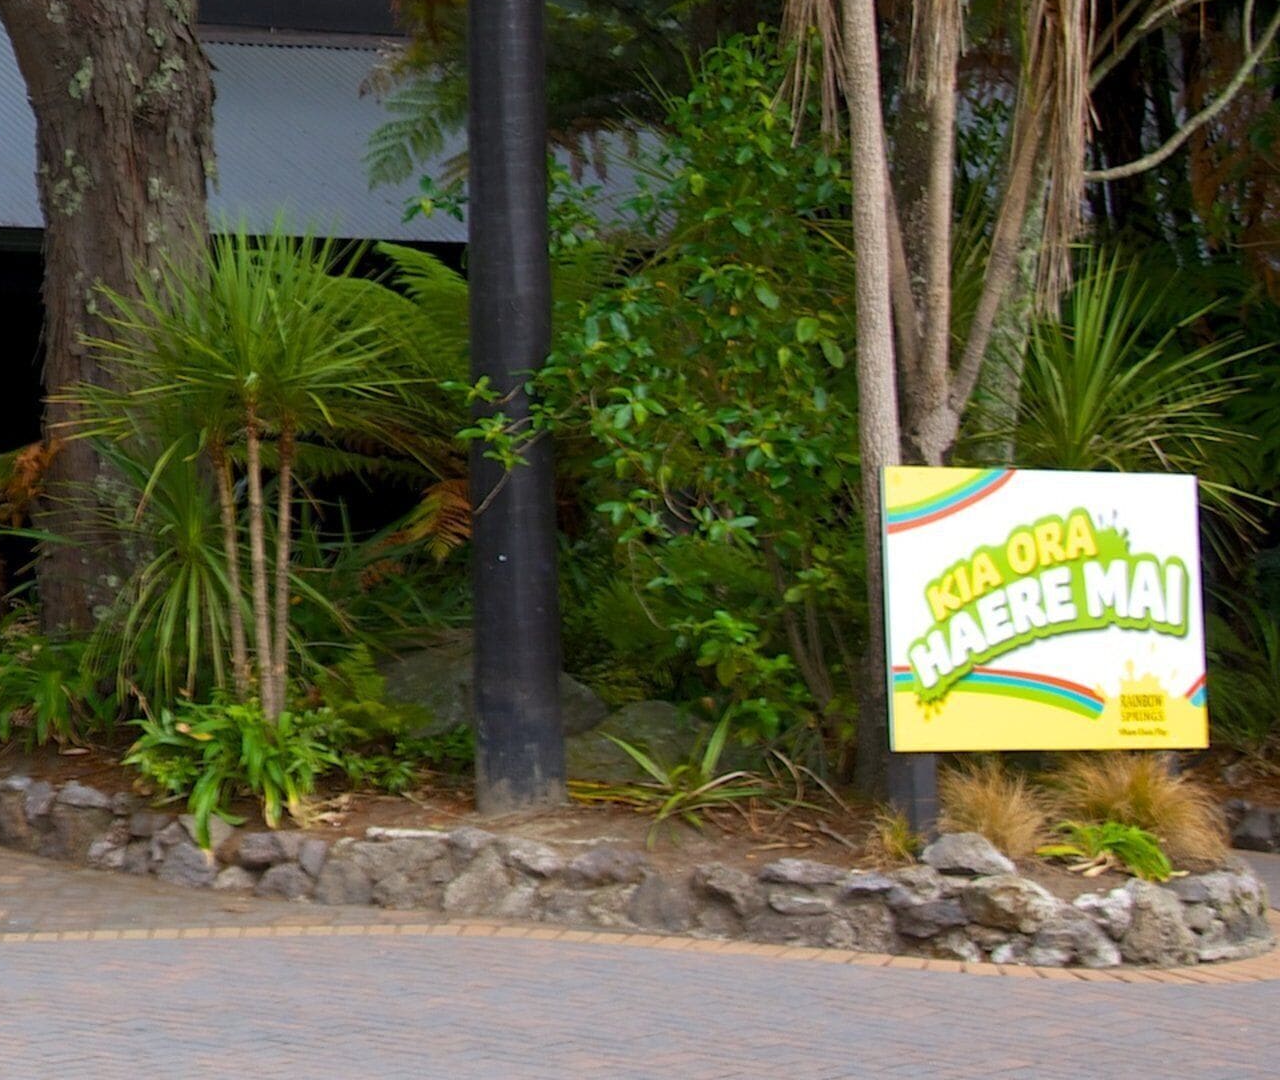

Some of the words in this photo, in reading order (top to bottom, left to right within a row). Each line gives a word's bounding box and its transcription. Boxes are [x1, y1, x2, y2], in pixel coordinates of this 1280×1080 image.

[910, 567, 1078, 688] HAERE
[1083, 559, 1185, 626] MAI
[926, 552, 1003, 621] KIA
[1007, 514, 1098, 575] ORA
